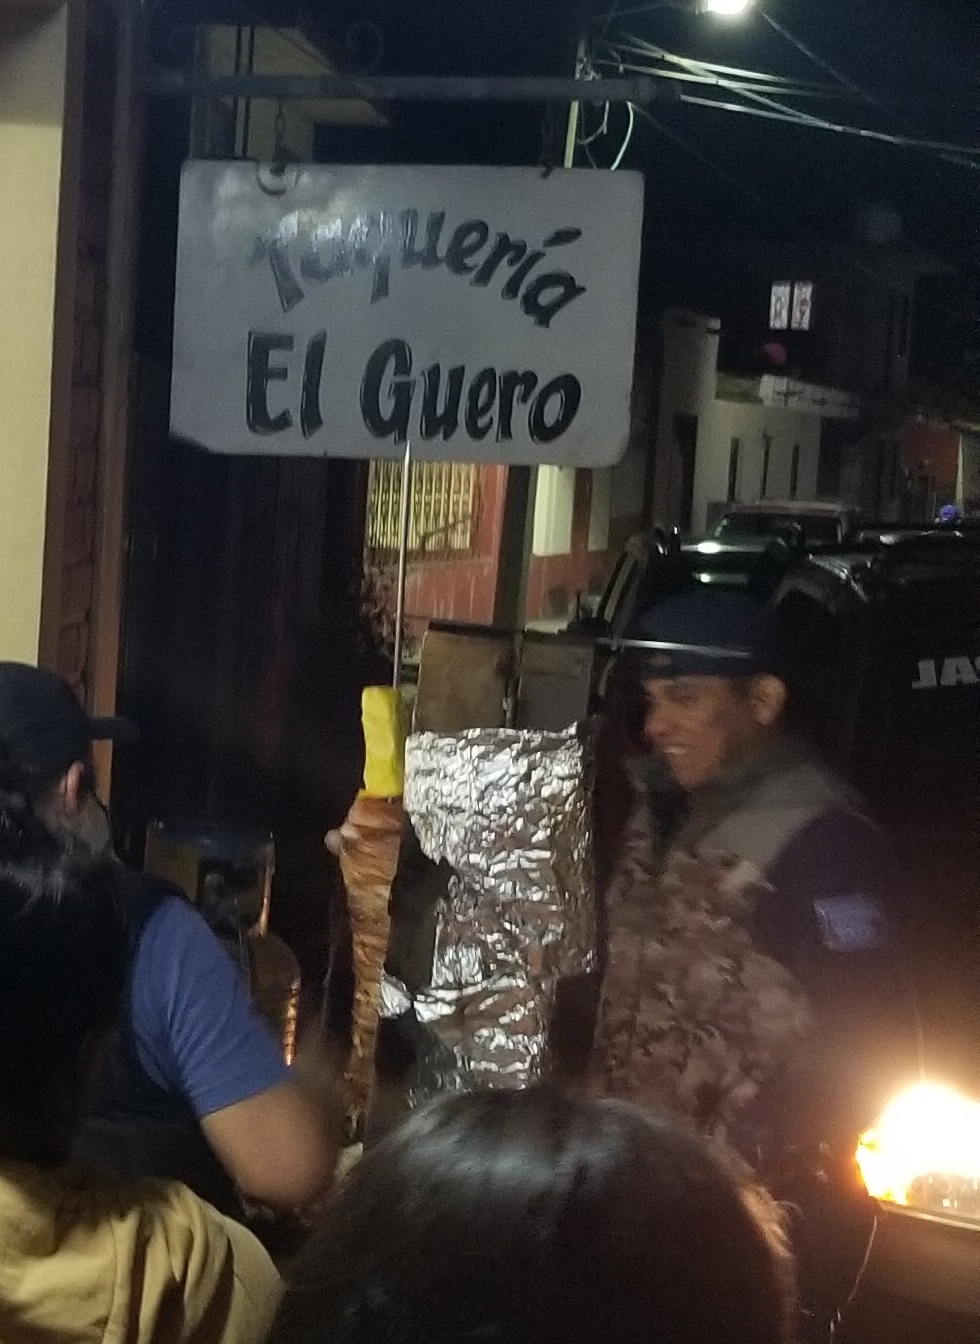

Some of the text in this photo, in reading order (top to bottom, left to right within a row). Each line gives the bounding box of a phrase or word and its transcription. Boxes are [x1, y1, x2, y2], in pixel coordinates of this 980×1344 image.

[250, 208, 587, 328] Taquería
[246, 330, 582, 444] El Guero
